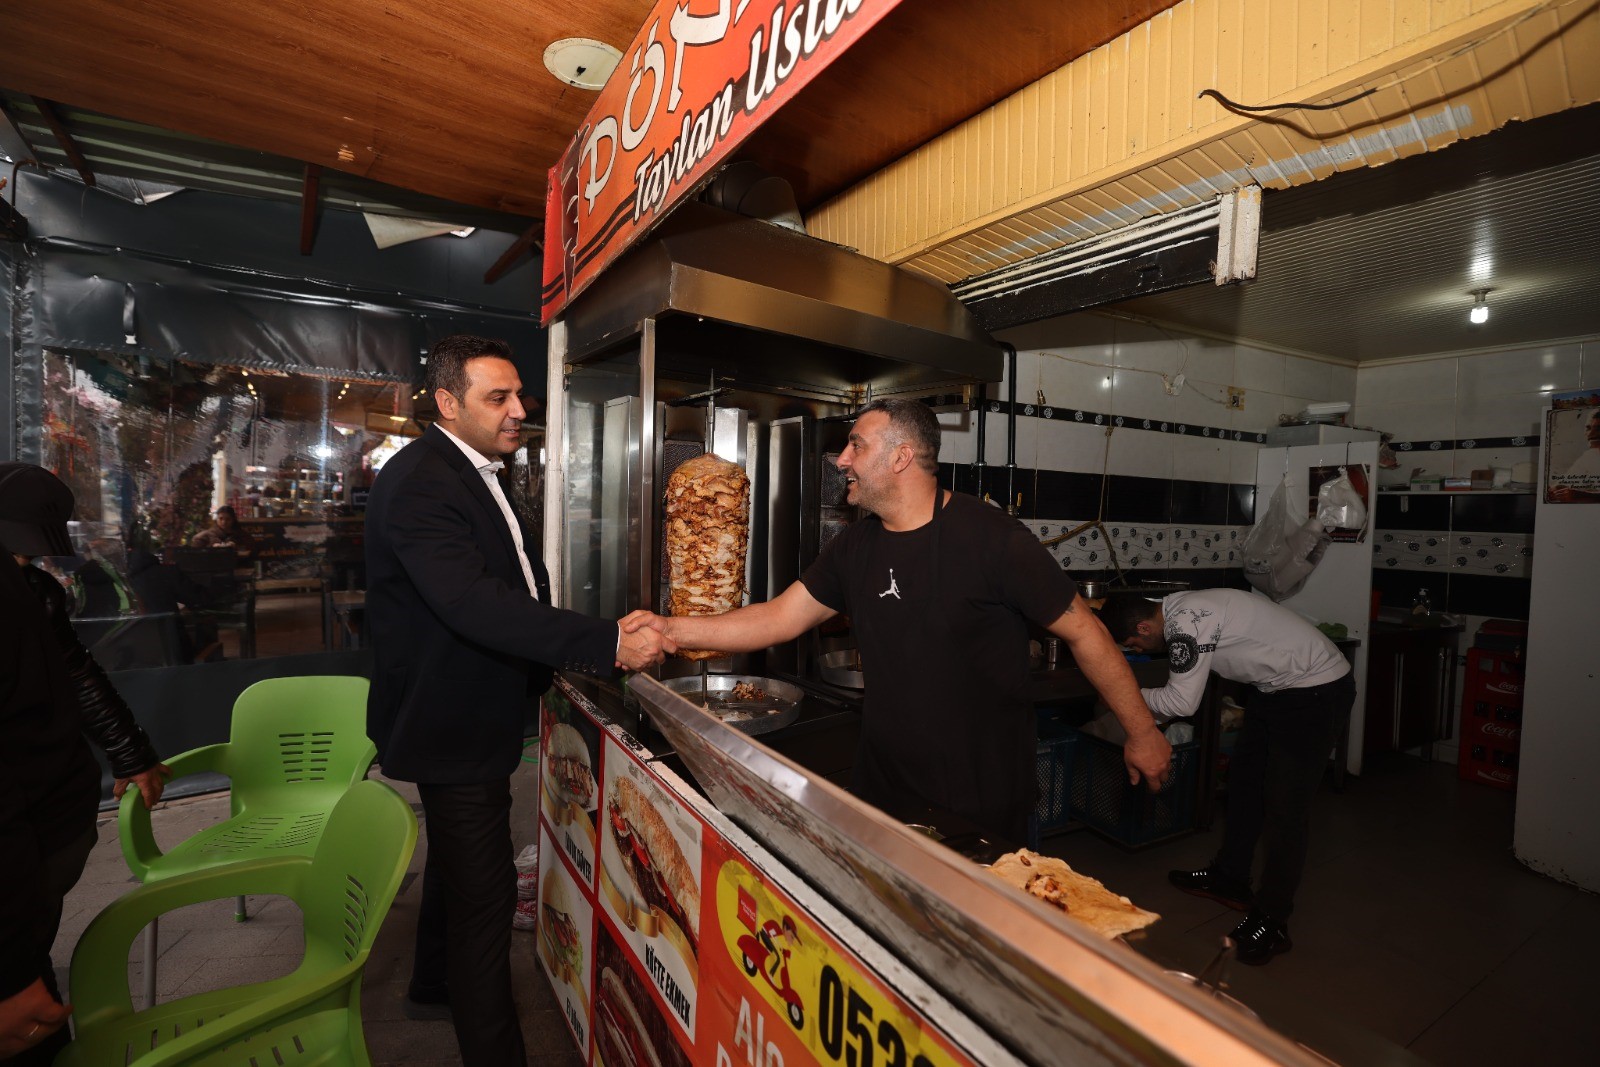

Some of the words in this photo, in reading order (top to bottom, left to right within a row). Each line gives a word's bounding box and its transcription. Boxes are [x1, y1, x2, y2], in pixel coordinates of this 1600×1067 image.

[580, 0, 751, 217] DÖN
[633, 80, 737, 223] Taylan
[645, 942, 666, 991] KÖFTE
[665, 971, 691, 1029] EKMEK
[818, 964, 936, 1067] 053
